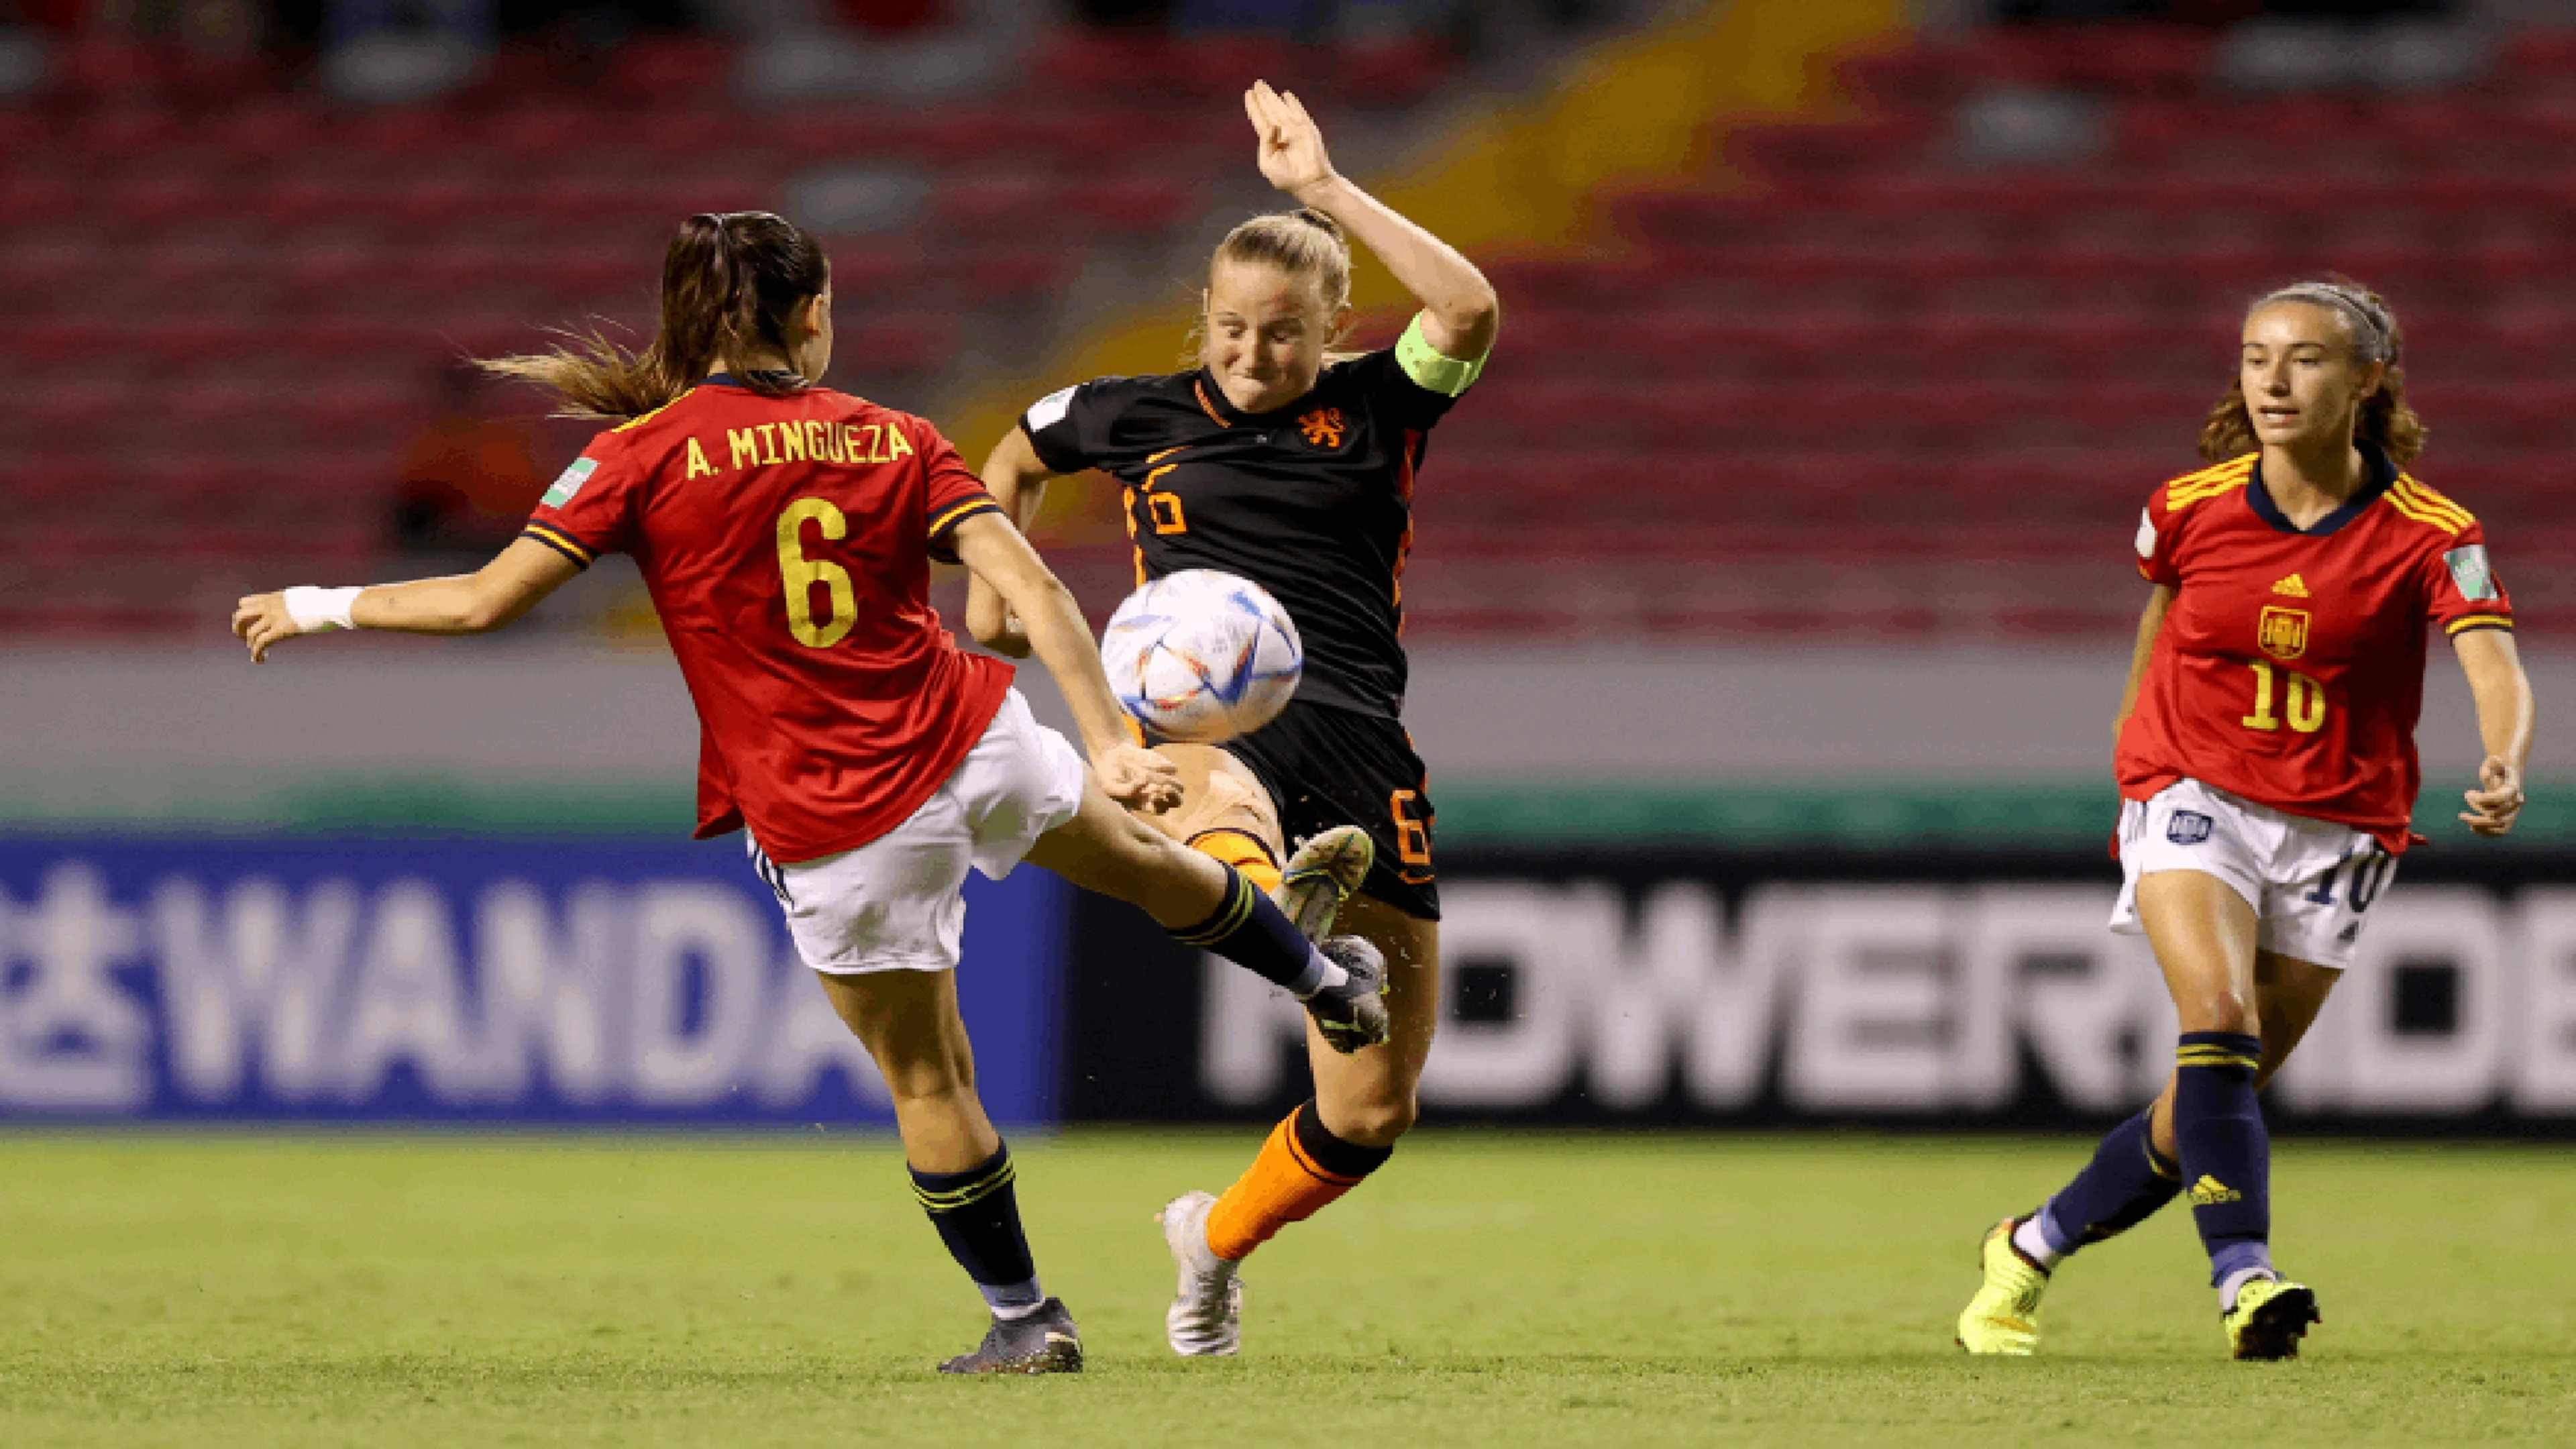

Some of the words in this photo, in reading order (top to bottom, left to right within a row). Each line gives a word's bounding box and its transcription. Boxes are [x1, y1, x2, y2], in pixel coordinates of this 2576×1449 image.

[687, 437, 722, 480] A.
[727, 420, 914, 471] MINGUEZA
[1141, 445, 1189, 535] 6
[776, 496, 858, 648] 6
[2242, 660, 2326, 733] 10
[1389, 789, 1431, 865] 6
[2304, 841, 2392, 913] 10
